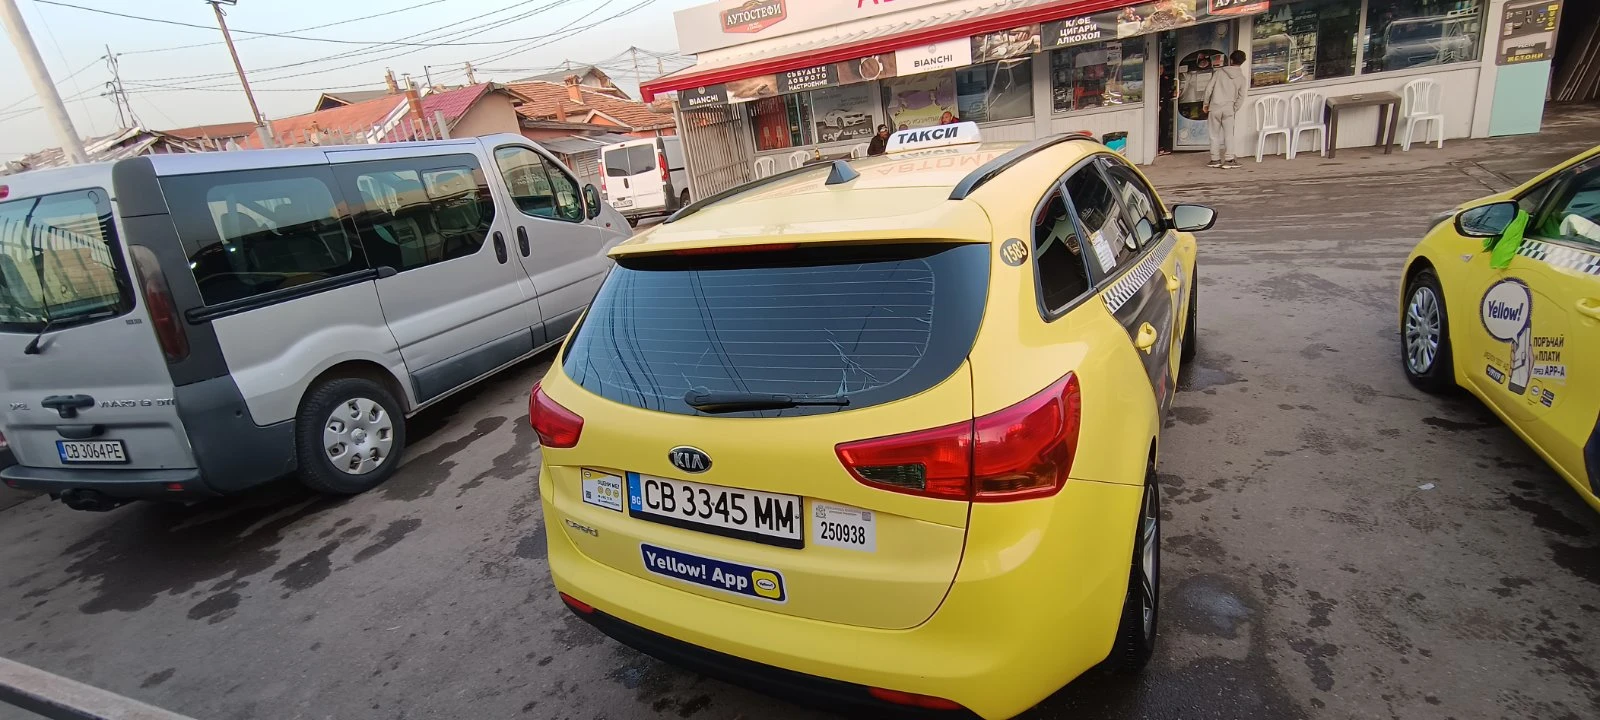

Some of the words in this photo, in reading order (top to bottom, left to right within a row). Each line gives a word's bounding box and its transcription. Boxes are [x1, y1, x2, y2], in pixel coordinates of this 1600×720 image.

[727, 3, 782, 26] АУТОСТЕФИ
[1065, 16, 1091, 28] КАФЕ
[1060, 24, 1097, 37] ЦИГАРИ
[1056, 31, 1101, 46] АЛКОХОЛ
[914, 54, 953, 68] BIANCHI
[1507, 52, 1544, 62] ЖЕТОНИ
[786, 66, 826, 78] СЪБУДЕТЕ
[788, 73, 827, 85] ДОБРОТО
[788, 80, 828, 91] НАСТРОЕНИЕ
[689, 94, 719, 106] BIANCHI
[898, 126, 959, 144] ТАКСИ
[1002, 240, 1028, 264] 1583
[1488, 300, 1524, 322] Yellow!
[1533, 333, 1565, 348] ПОРЪЧАЙ
[1538, 350, 1561, 362] ПЛАТИ
[1544, 365, 1565, 377] APP-A
[65, 443, 80, 459] CB
[81, 443, 106, 459] 3064
[106, 443, 122, 459] PE
[673, 451, 705, 470] KIA
[631, 495, 642, 506] BG
[644, 480, 676, 513] CB
[682, 485, 748, 525] 3345
[754, 495, 794, 534] MM
[820, 521, 866, 545] 250938
[646, 551, 707, 580] Yellow!
[712, 567, 748, 591] App
